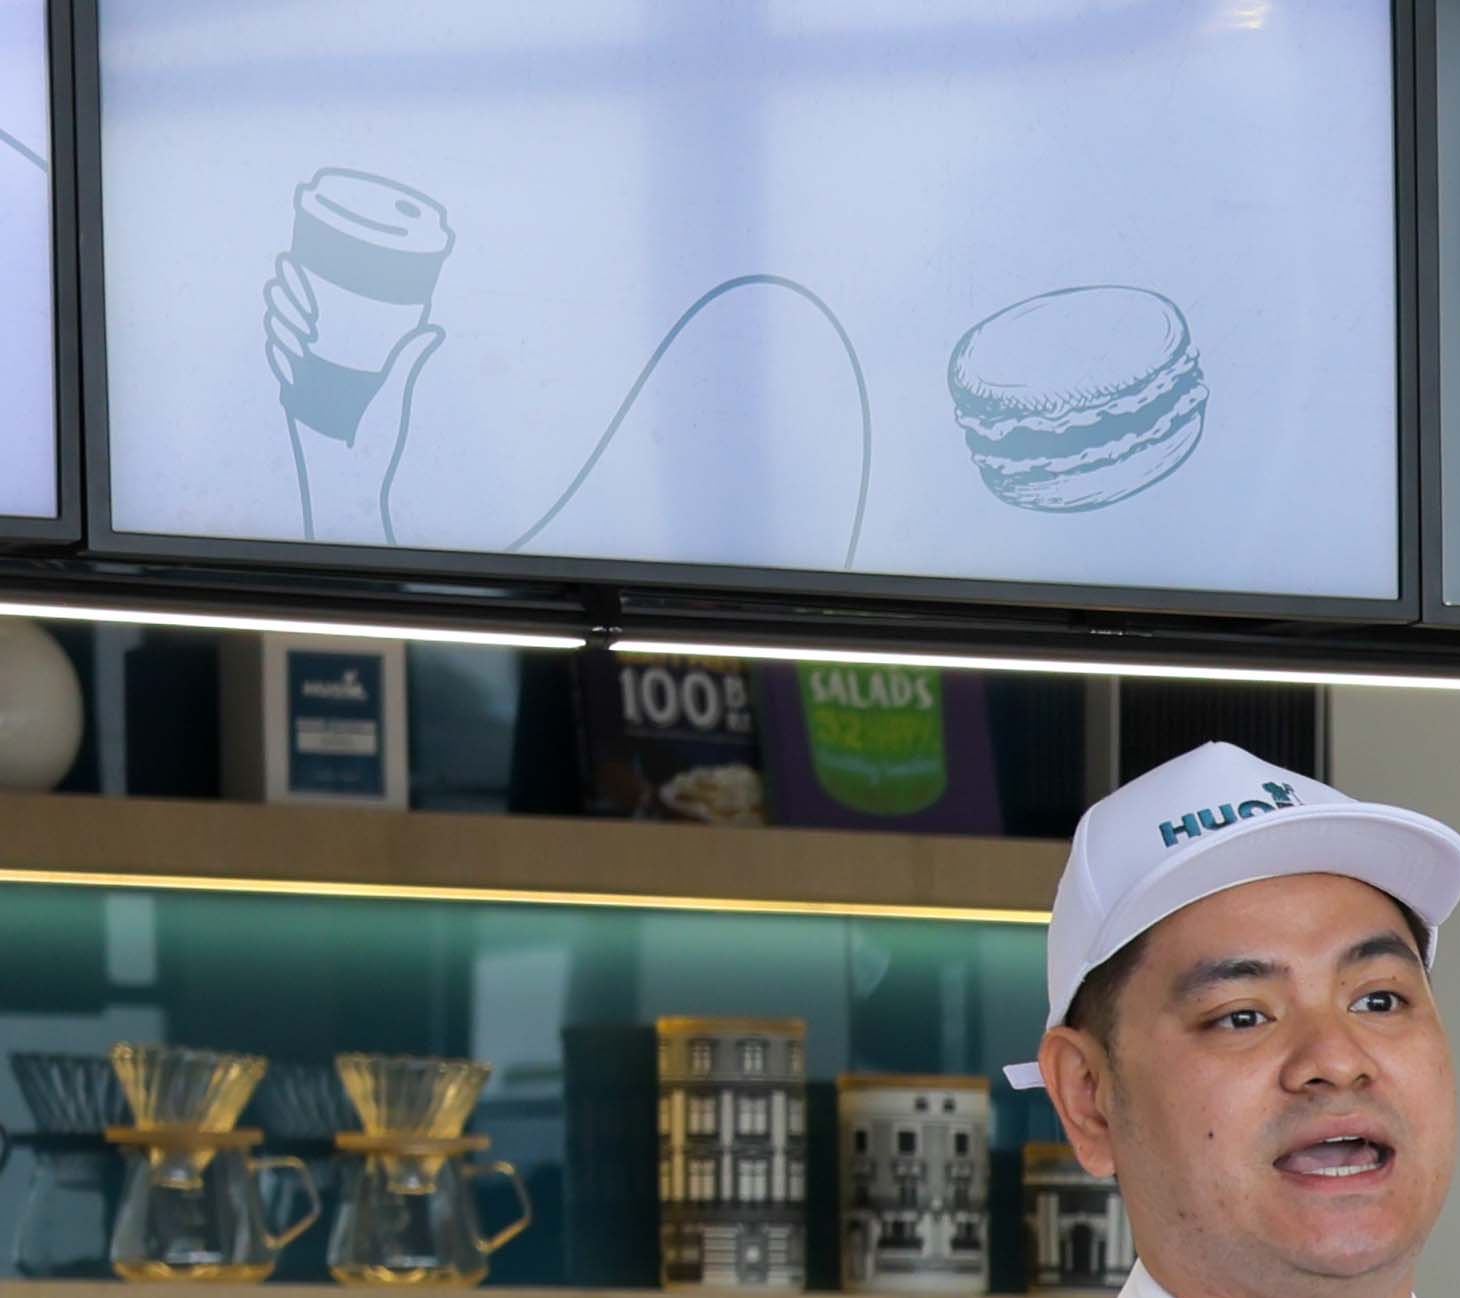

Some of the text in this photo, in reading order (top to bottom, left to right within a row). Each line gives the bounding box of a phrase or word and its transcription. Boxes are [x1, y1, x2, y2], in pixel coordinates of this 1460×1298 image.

[619, 667, 720, 729] 100
[810, 666, 933, 710] SALADS
[1158, 799, 1294, 848] HUO
